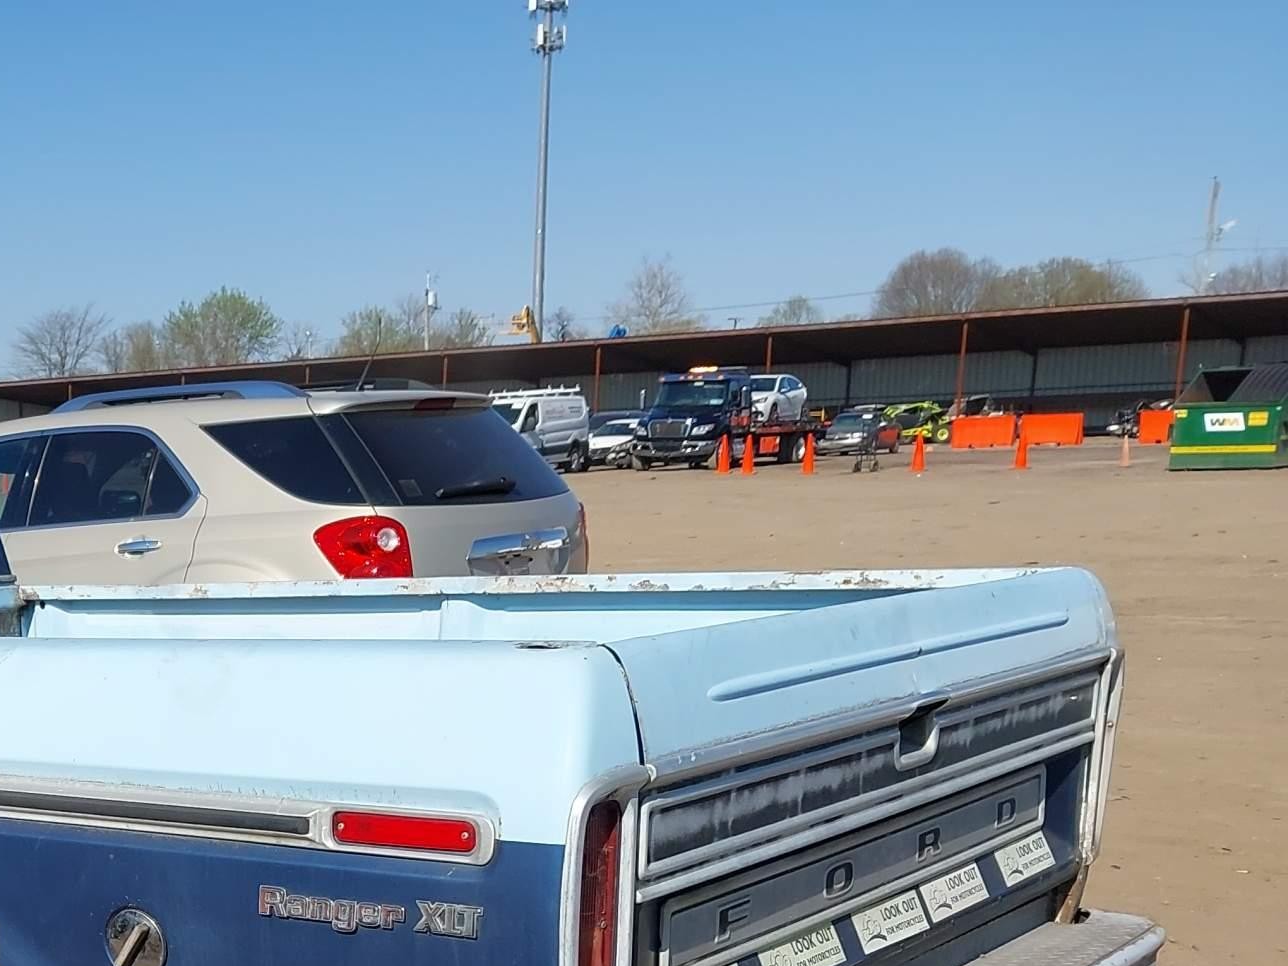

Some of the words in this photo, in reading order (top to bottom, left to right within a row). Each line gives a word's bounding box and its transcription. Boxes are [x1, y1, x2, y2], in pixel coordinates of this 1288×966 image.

[1016, 842, 1033, 858] LOOK
[1032, 836, 1045, 850] OUT
[944, 872, 965, 891] LOOK
[963, 866, 978, 882] OUT
[257, 884, 406, 933] Ranger
[412, 899, 484, 939] XLT
[879, 902, 903, 921] LOOK
[901, 896, 918, 913] OUT
[790, 934, 816, 956] LOOK
[815, 927, 834, 944] OUT
[806, 945, 841, 966] MOTORCYCLES
